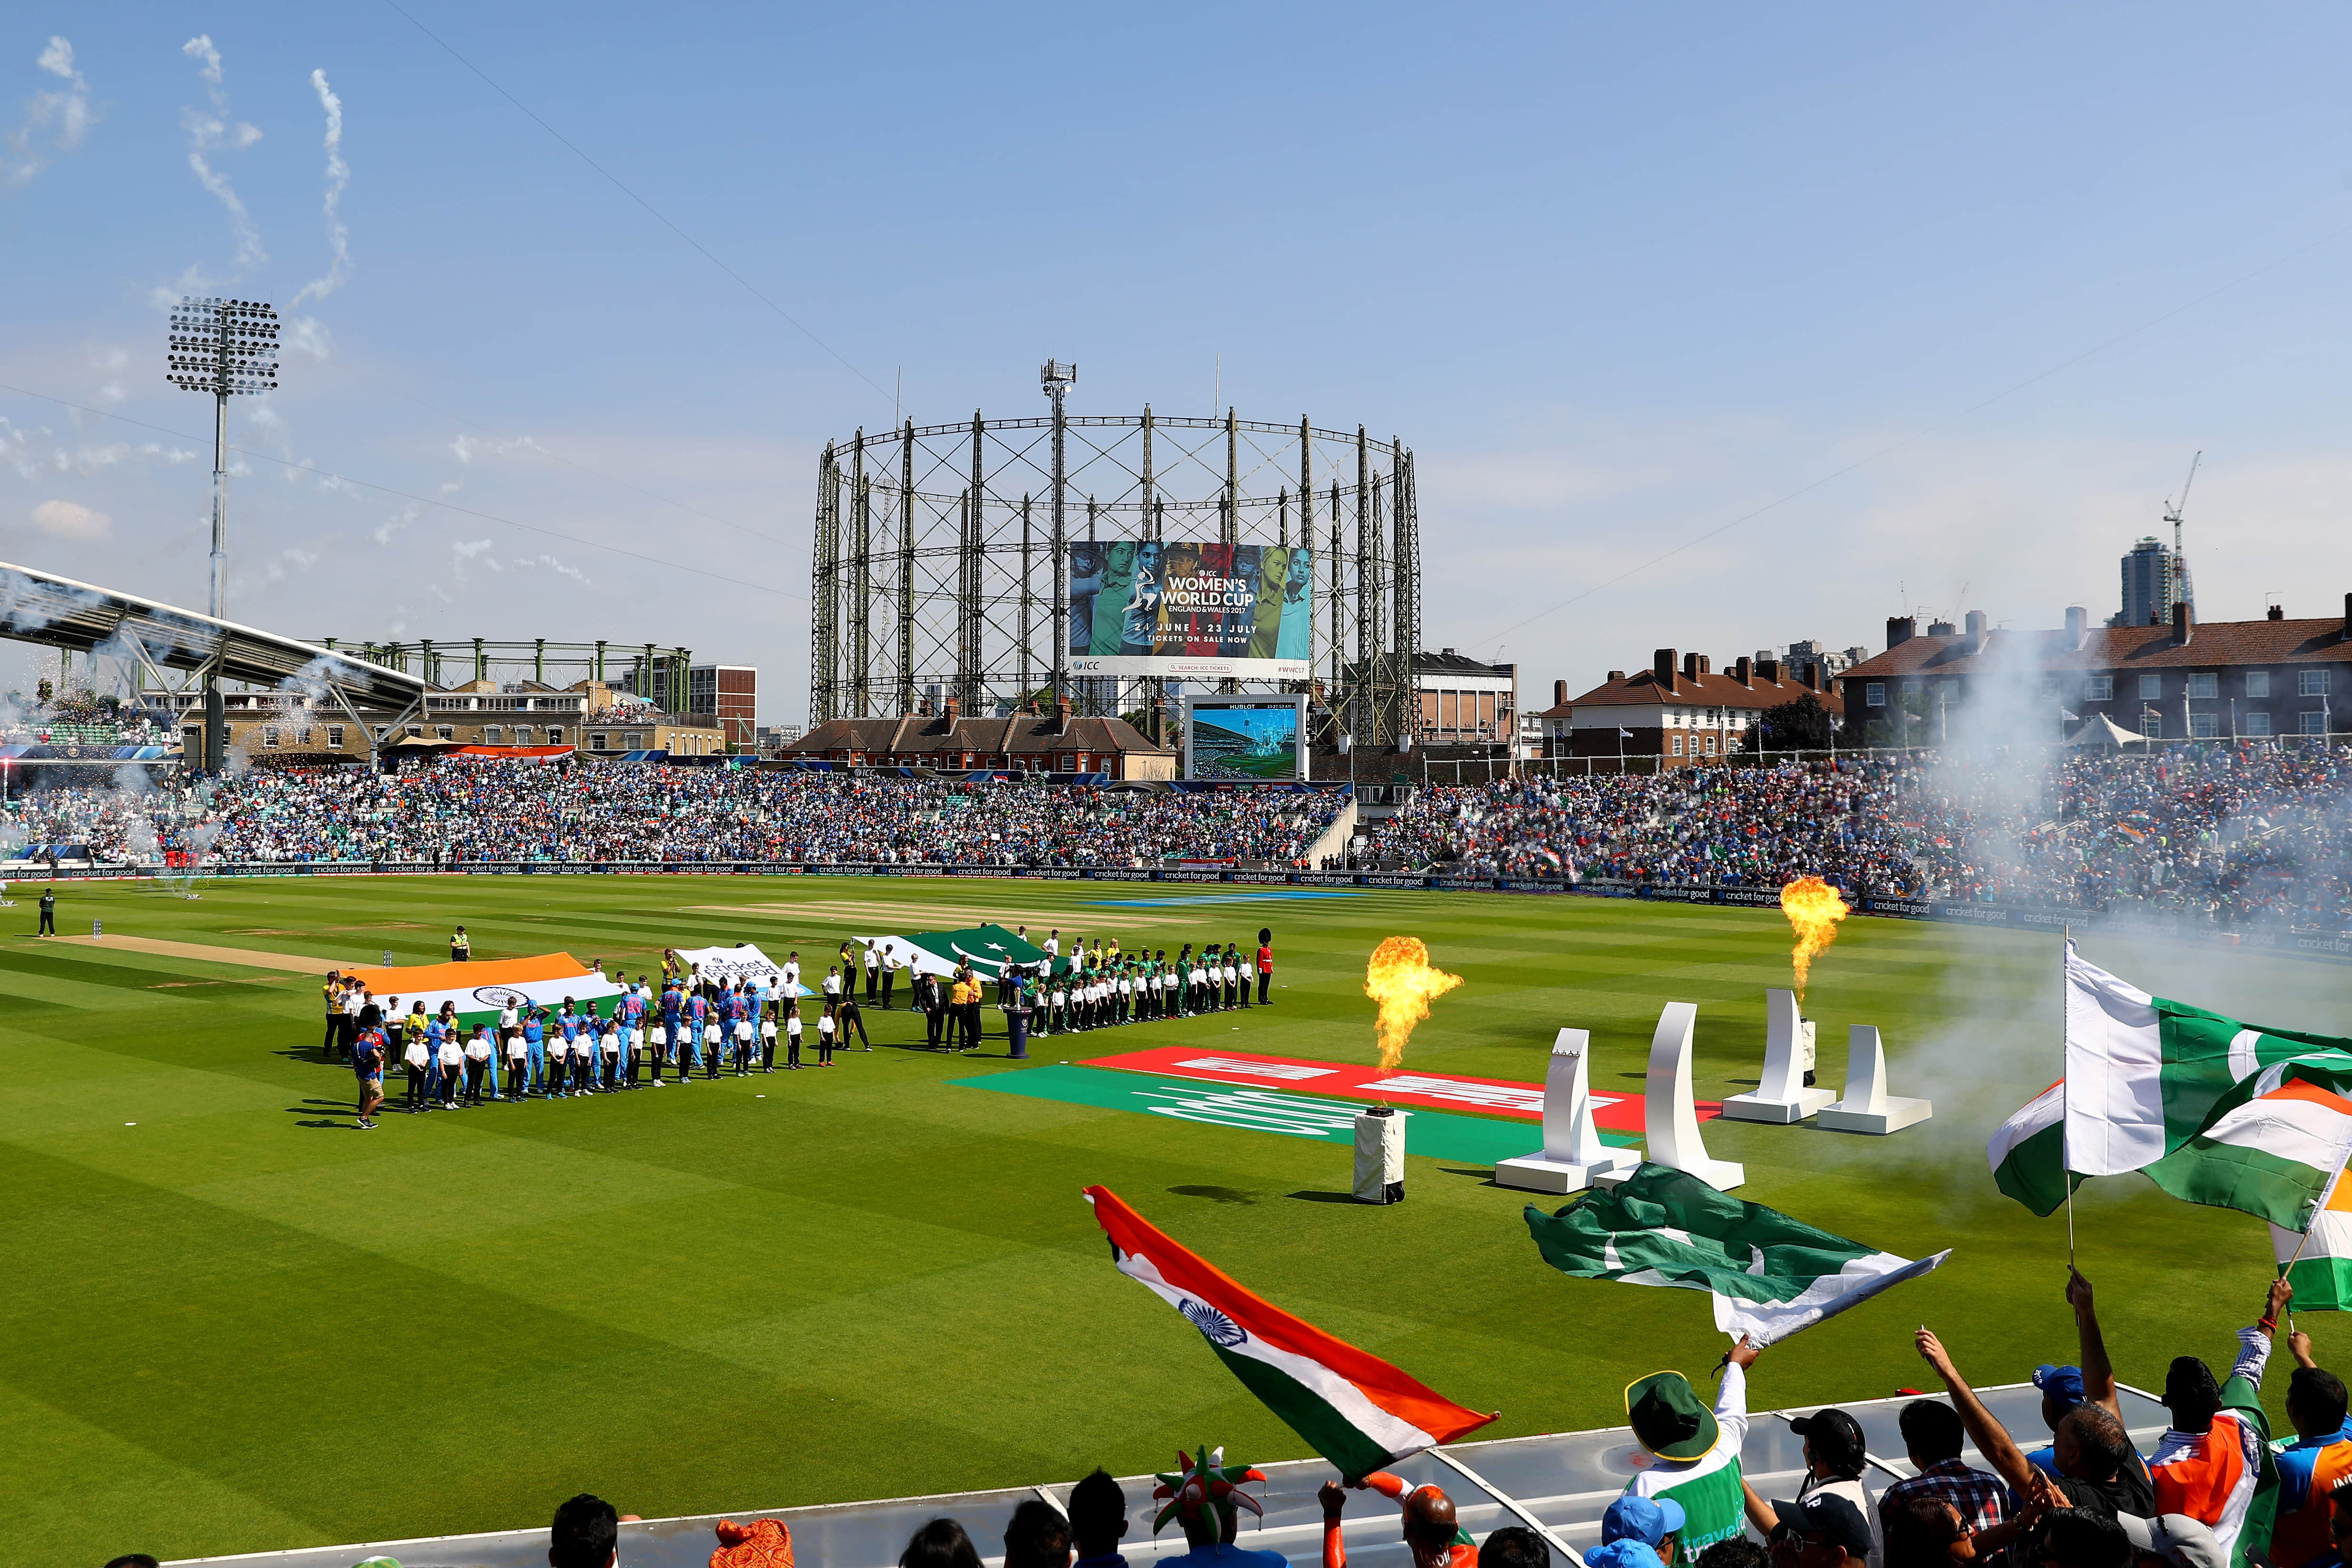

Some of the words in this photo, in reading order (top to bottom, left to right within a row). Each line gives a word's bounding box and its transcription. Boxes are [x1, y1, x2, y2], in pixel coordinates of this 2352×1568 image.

[1168, 577, 1246, 592] WOMEN'S
[1160, 591, 1221, 605] WORLD
[1223, 593, 1254, 607] CUP
[1135, 623, 1149, 631] 24
[1157, 623, 1189, 632] JUNE
[1207, 624, 1222, 633] 23
[1229, 625, 1257, 634] JULY
[1084, 662, 1100, 671] ICC
[31, 870, 52, 879] good
[115, 868, 136, 877] good
[276, 866, 295, 874] good
[1202, 872, 1219, 880] good
[1336, 875, 1353, 885] good
[1690, 889, 1709, 899] good
[1726, 891, 1752, 900] cricket
[1753, 892, 1765, 901] for
[1765, 895, 1779, 904] goo
[1874, 901, 1899, 911] cricket
[1900, 902, 1909, 912] for
[1910, 904, 1930, 915] good
[1946, 906, 1972, 917] cricket
[1974, 907, 1986, 918] for
[1986, 910, 2006, 921] good
[2024, 913, 2052, 924] cricket
[2053, 914, 2065, 925] for
[2067, 916, 2088, 928] good
[2298, 937, 2333, 950] cricket
[2335, 939, 2351, 952] for
[704, 970, 733, 978] for
[734, 965, 781, 979] good
[705, 960, 766, 972] cricket
[627, 1001, 641, 1014] 99
